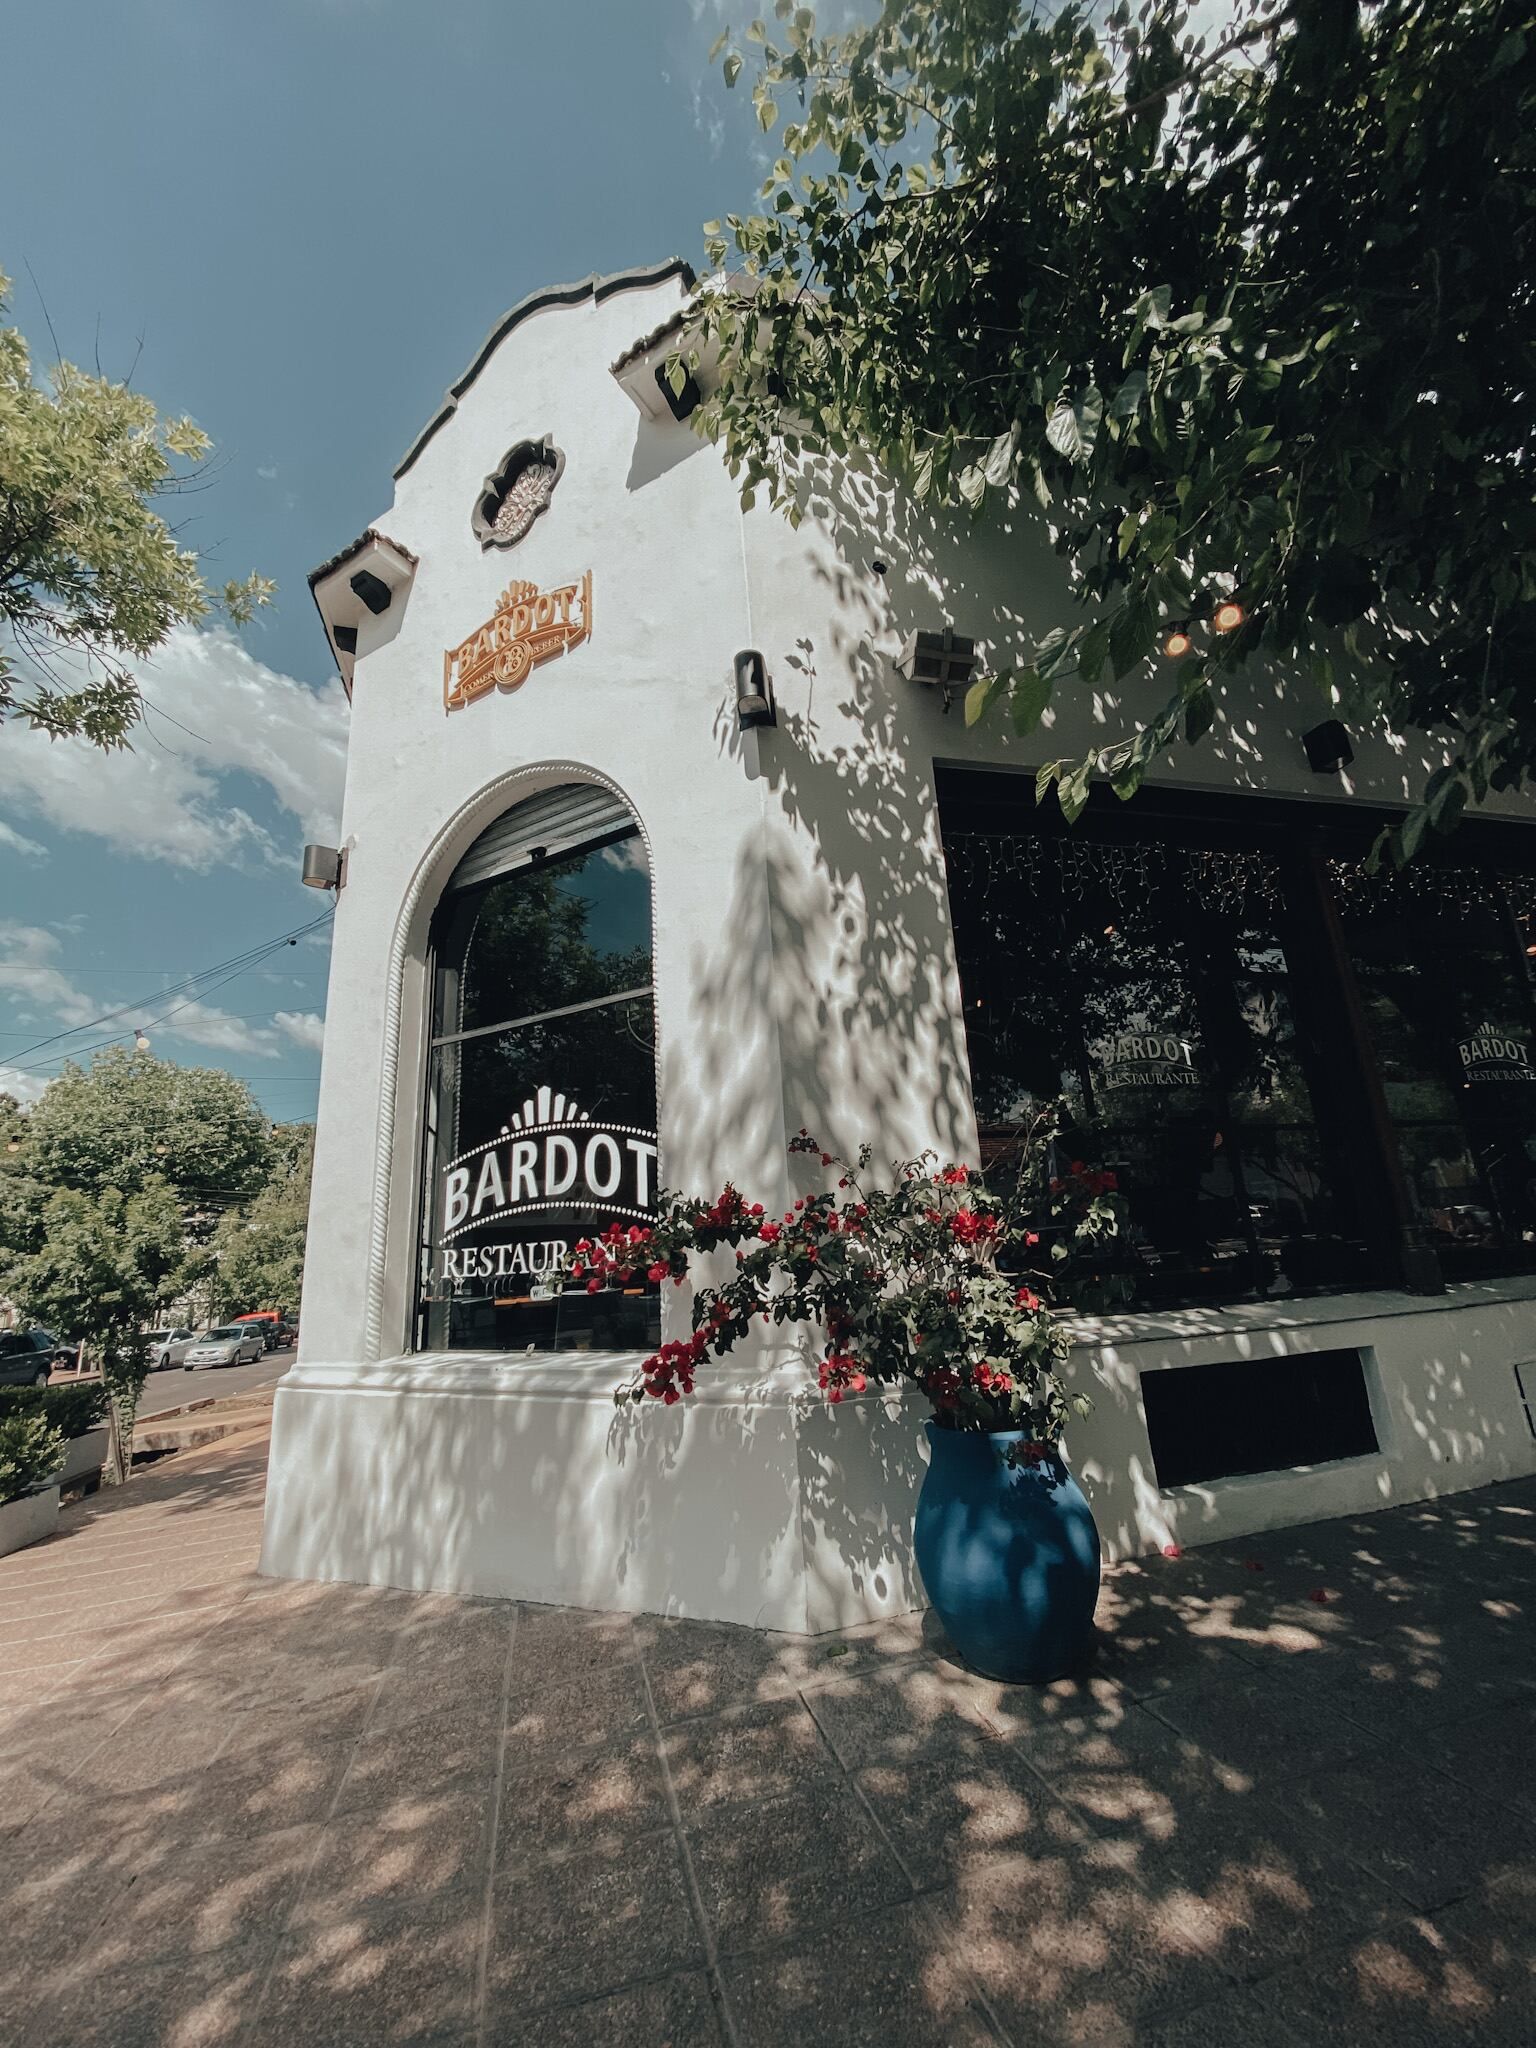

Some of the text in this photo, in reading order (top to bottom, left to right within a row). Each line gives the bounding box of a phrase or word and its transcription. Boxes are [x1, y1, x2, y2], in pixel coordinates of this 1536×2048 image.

[458, 588, 575, 679] BARDOT
[1101, 1036, 1193, 1067] BARDOT
[1459, 1038, 1528, 1066] BARDOT
[444, 1133, 657, 1233] BARDOT
